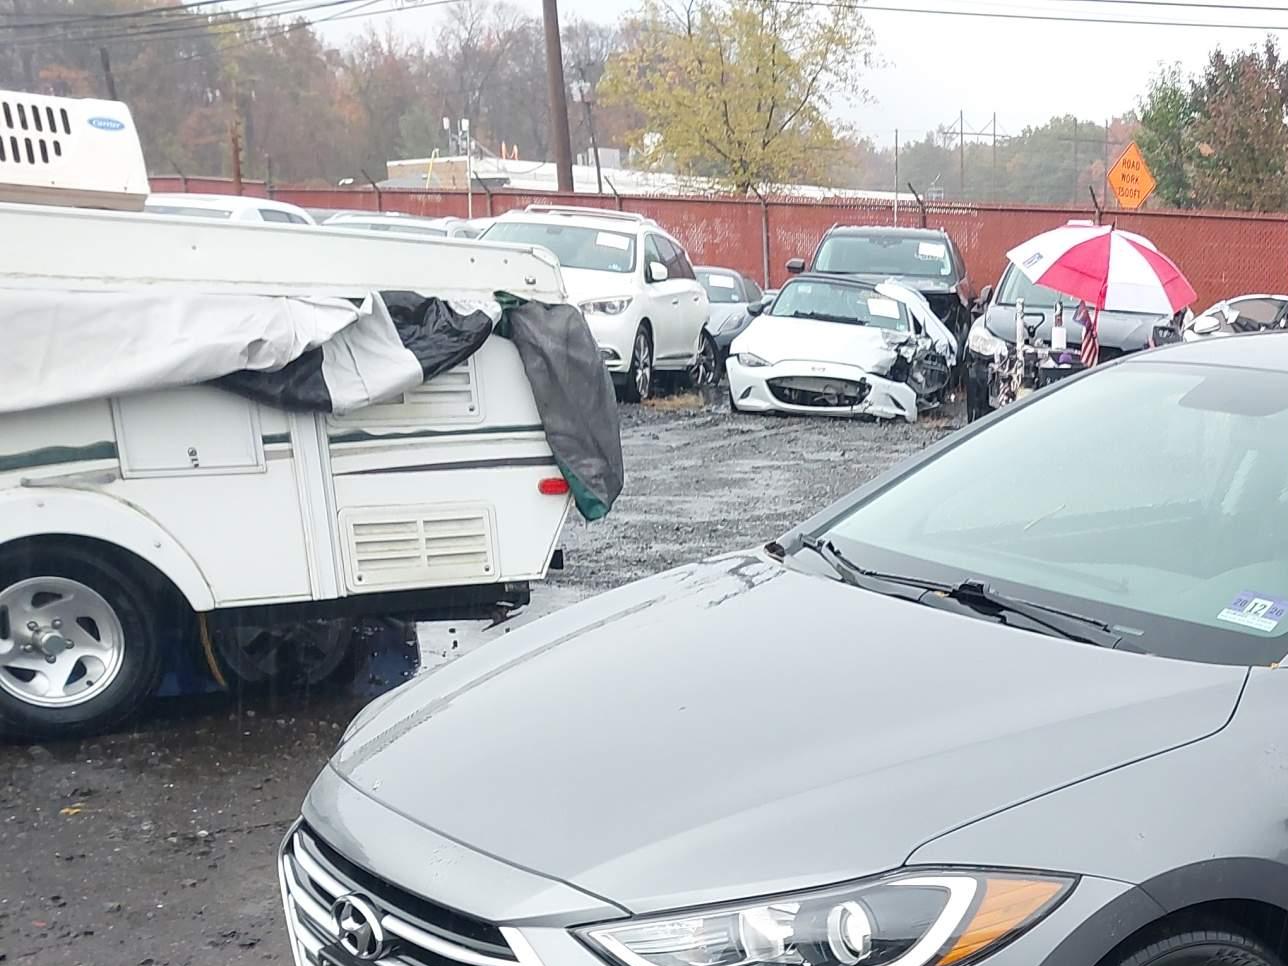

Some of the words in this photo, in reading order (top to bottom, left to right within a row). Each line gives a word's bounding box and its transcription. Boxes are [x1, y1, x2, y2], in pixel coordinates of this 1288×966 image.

[91, 118, 122, 130] Carrier
[1121, 158, 1141, 170] ROAD
[1121, 173, 1140, 185] WORK
[1233, 598, 1249, 608] 20
[1246, 602, 1267, 615] 12
[1268, 606, 1285, 617] 26
